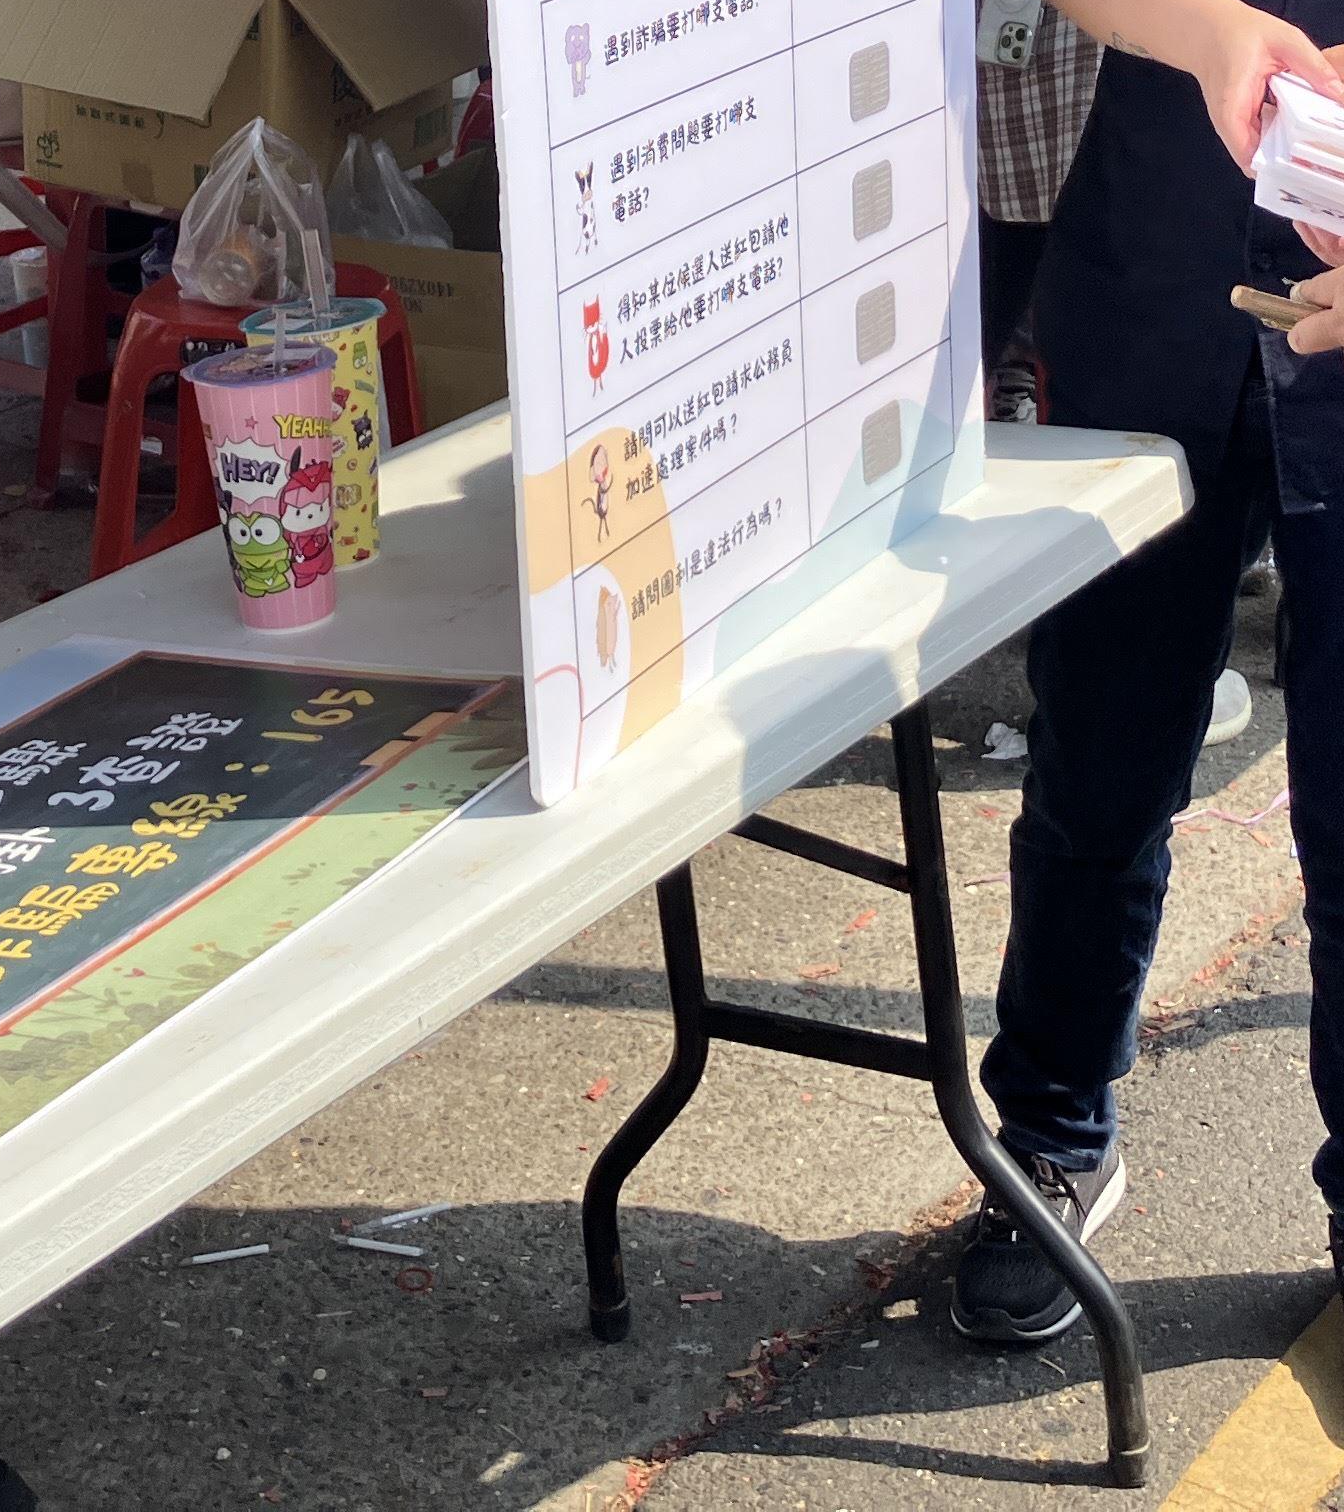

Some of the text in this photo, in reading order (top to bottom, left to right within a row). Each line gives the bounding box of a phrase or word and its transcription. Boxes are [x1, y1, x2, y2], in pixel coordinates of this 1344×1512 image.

[609, 95, 758, 185] 遇到消費問題要打哪支
[611, 186, 650, 224] 電話?
[617, 213, 789, 325] 得知某位候選人送紅包請他
[619, 257, 784, 365] 人投票給他要打哪支電話?
[623, 338, 793, 462] 請問可以送紅包請求公務員
[220, 452, 281, 485] HEY!
[625, 413, 738, 502] 加速處理案件嗎？
[631, 496, 783, 621] 請問圖利是違法行為嗎？
[48, 712, 244, 811] 3查證
